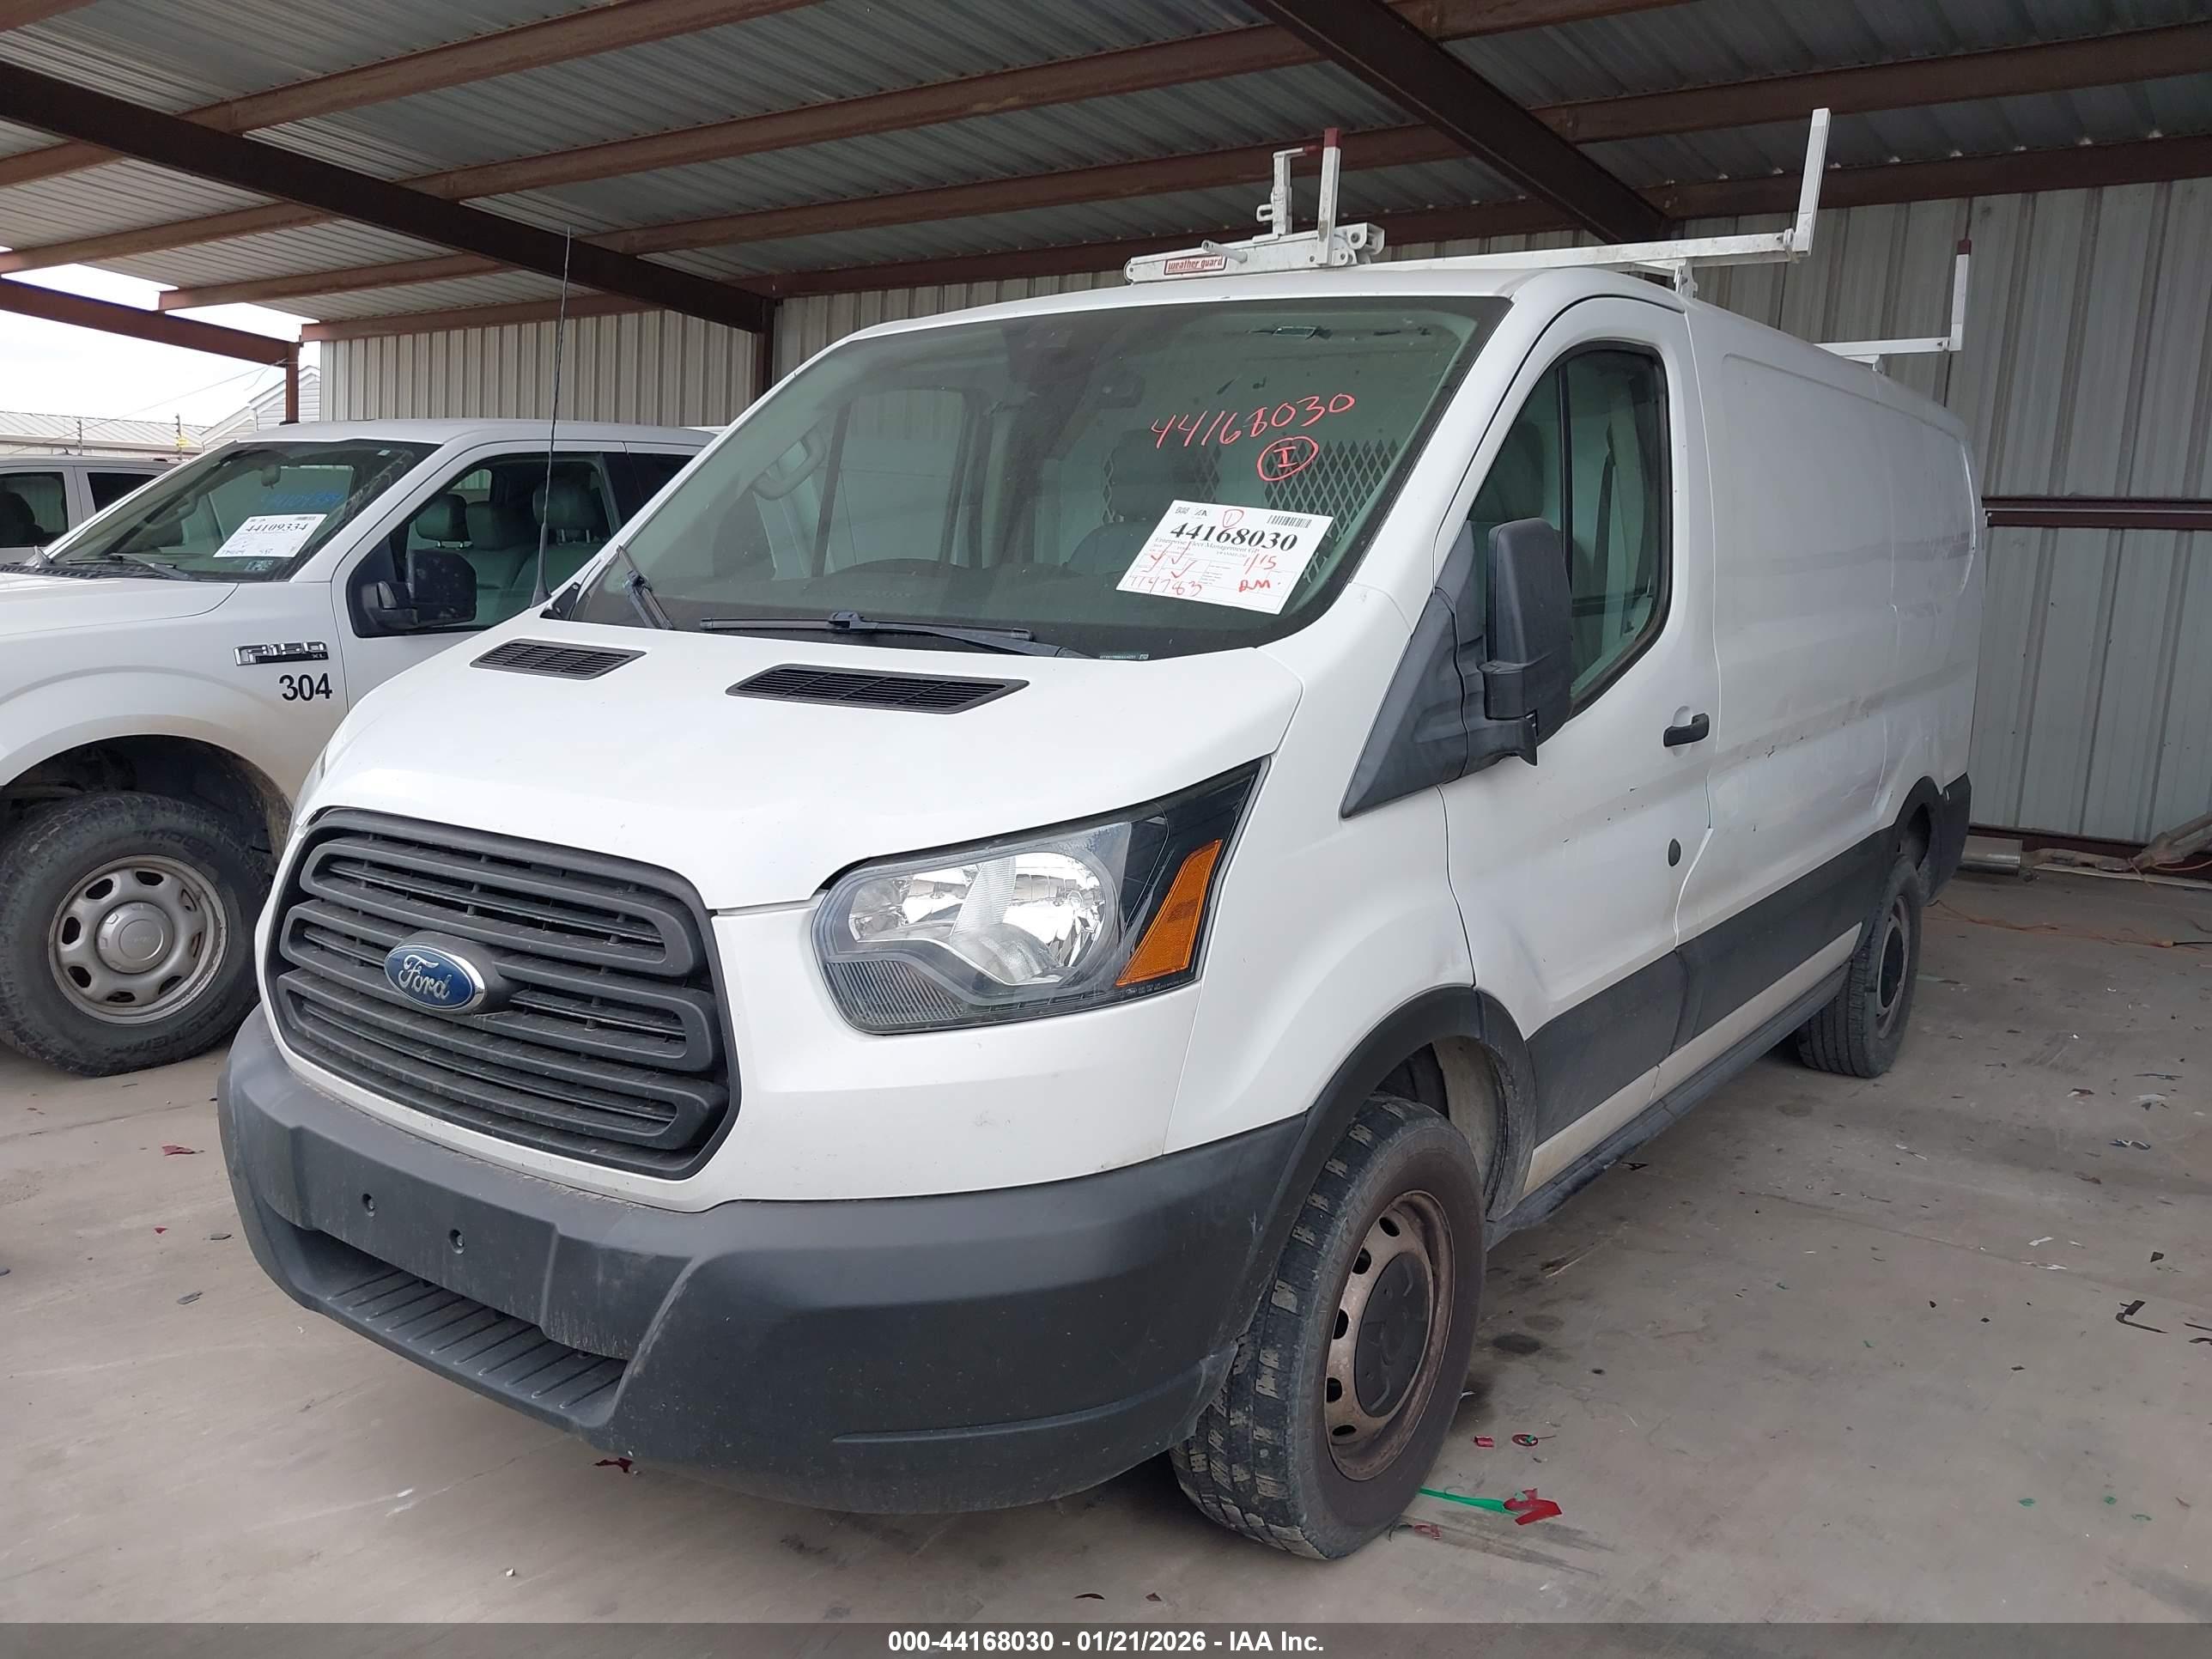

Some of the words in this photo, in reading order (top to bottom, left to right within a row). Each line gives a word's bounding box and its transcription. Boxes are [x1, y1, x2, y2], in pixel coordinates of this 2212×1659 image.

[1168, 260, 1200, 270] weather
[1200, 257, 1223, 269] guard
[1151, 393, 1355, 448] 44168030
[1170, 522, 1297, 551] 44168030
[279, 673, 332, 702] 304
[398, 954, 453, 1000] Ford
